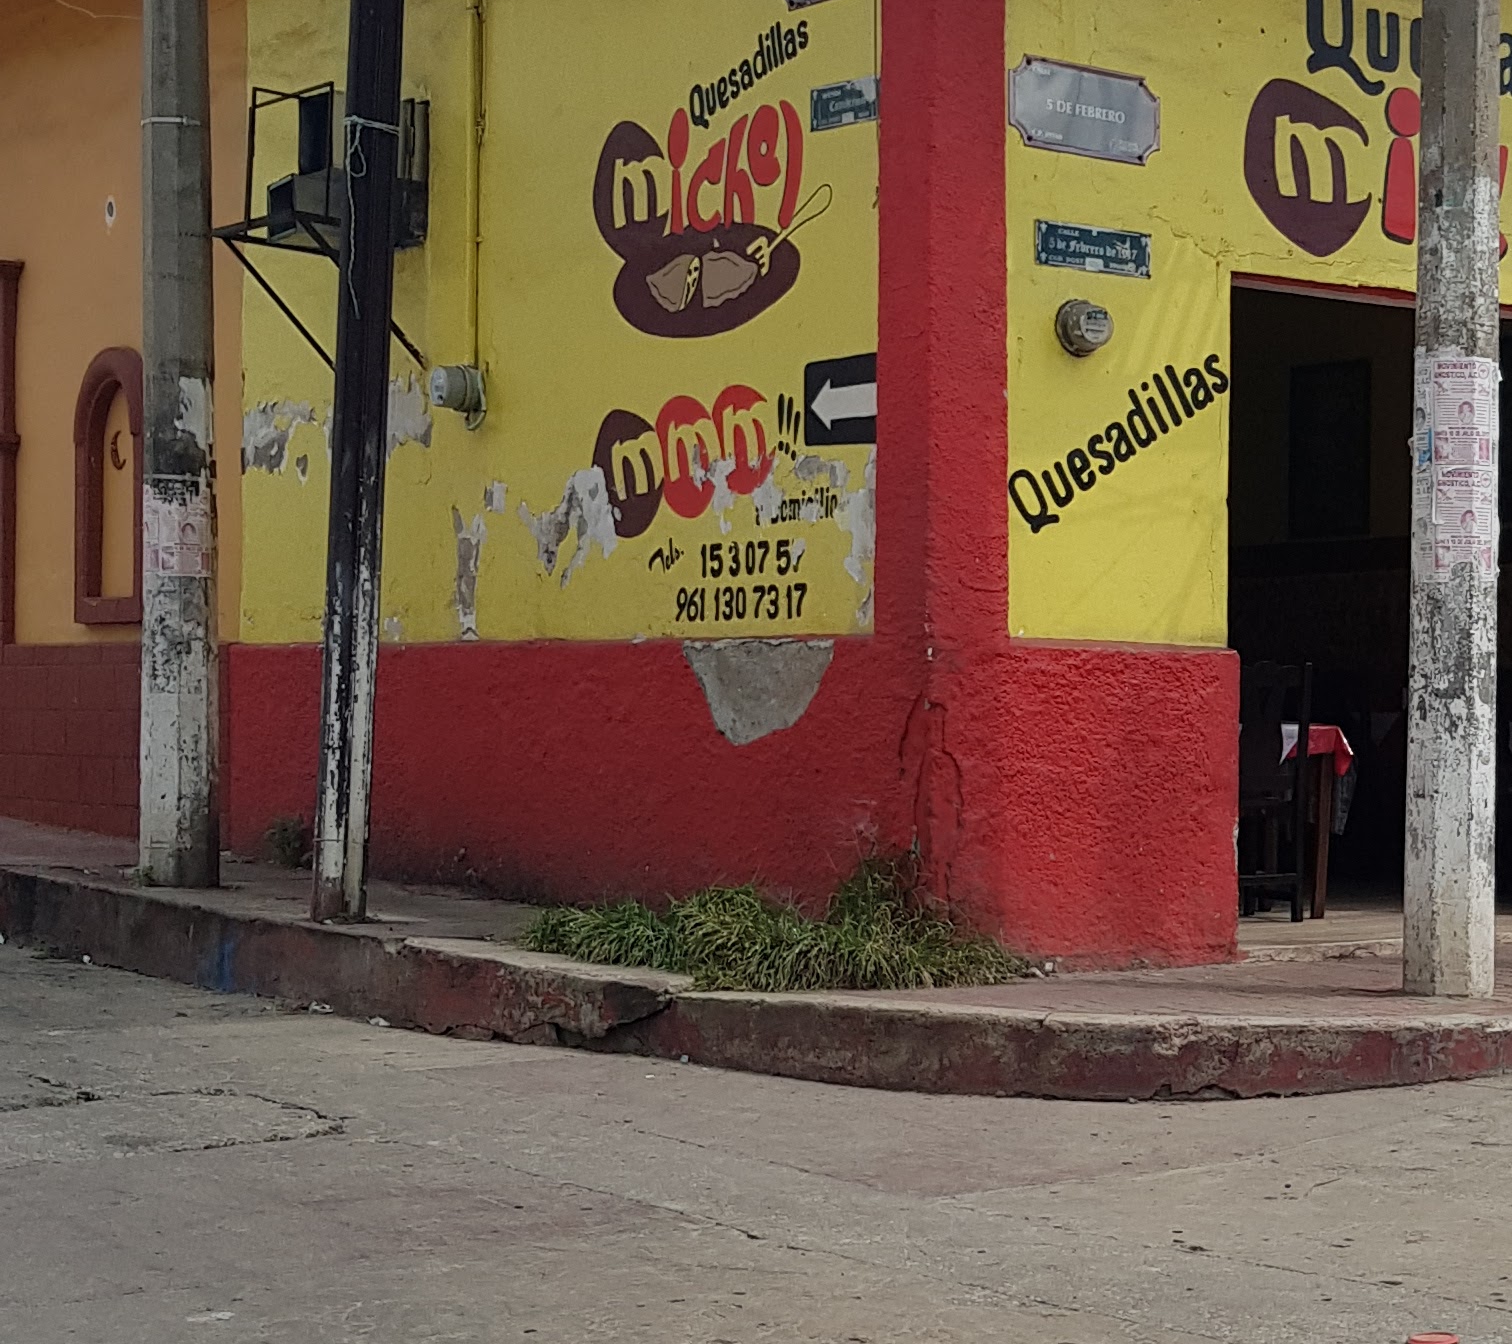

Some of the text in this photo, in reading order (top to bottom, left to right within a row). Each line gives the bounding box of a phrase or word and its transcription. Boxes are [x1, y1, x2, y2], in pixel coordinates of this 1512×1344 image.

[689, 20, 809, 129] Quesadillas
[1046, 99, 1126, 124] 5 DE FEBRERO
[1008, 353, 1228, 534] Quesadillas
[675, 587, 705, 622] 961
[713, 586, 746, 621] 130
